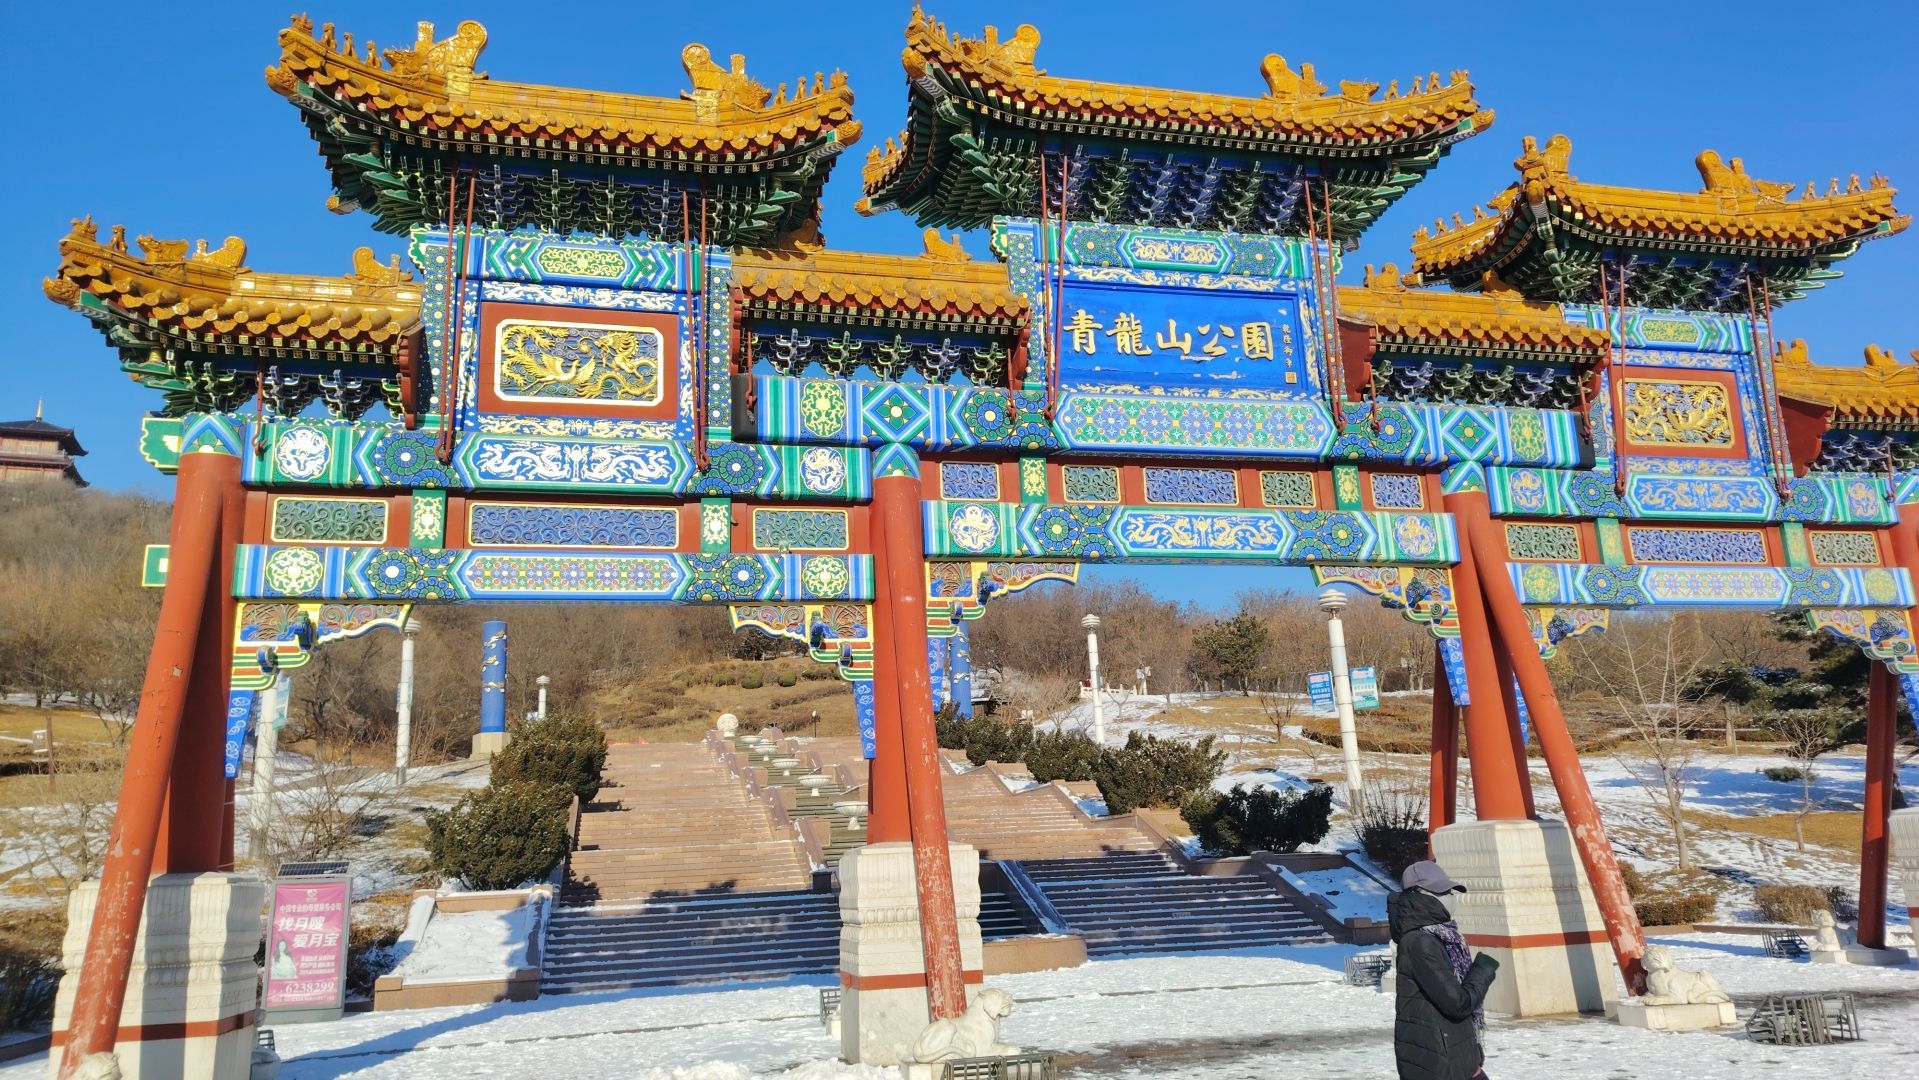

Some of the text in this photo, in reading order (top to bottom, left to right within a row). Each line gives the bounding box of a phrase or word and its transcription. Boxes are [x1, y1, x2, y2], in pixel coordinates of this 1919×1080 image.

[1063, 309, 1274, 361] 青龍山公園
[278, 916, 325, 932] 找月嫂
[292, 933, 340, 948] 爱月宝
[285, 981, 335, 993] 6238299
